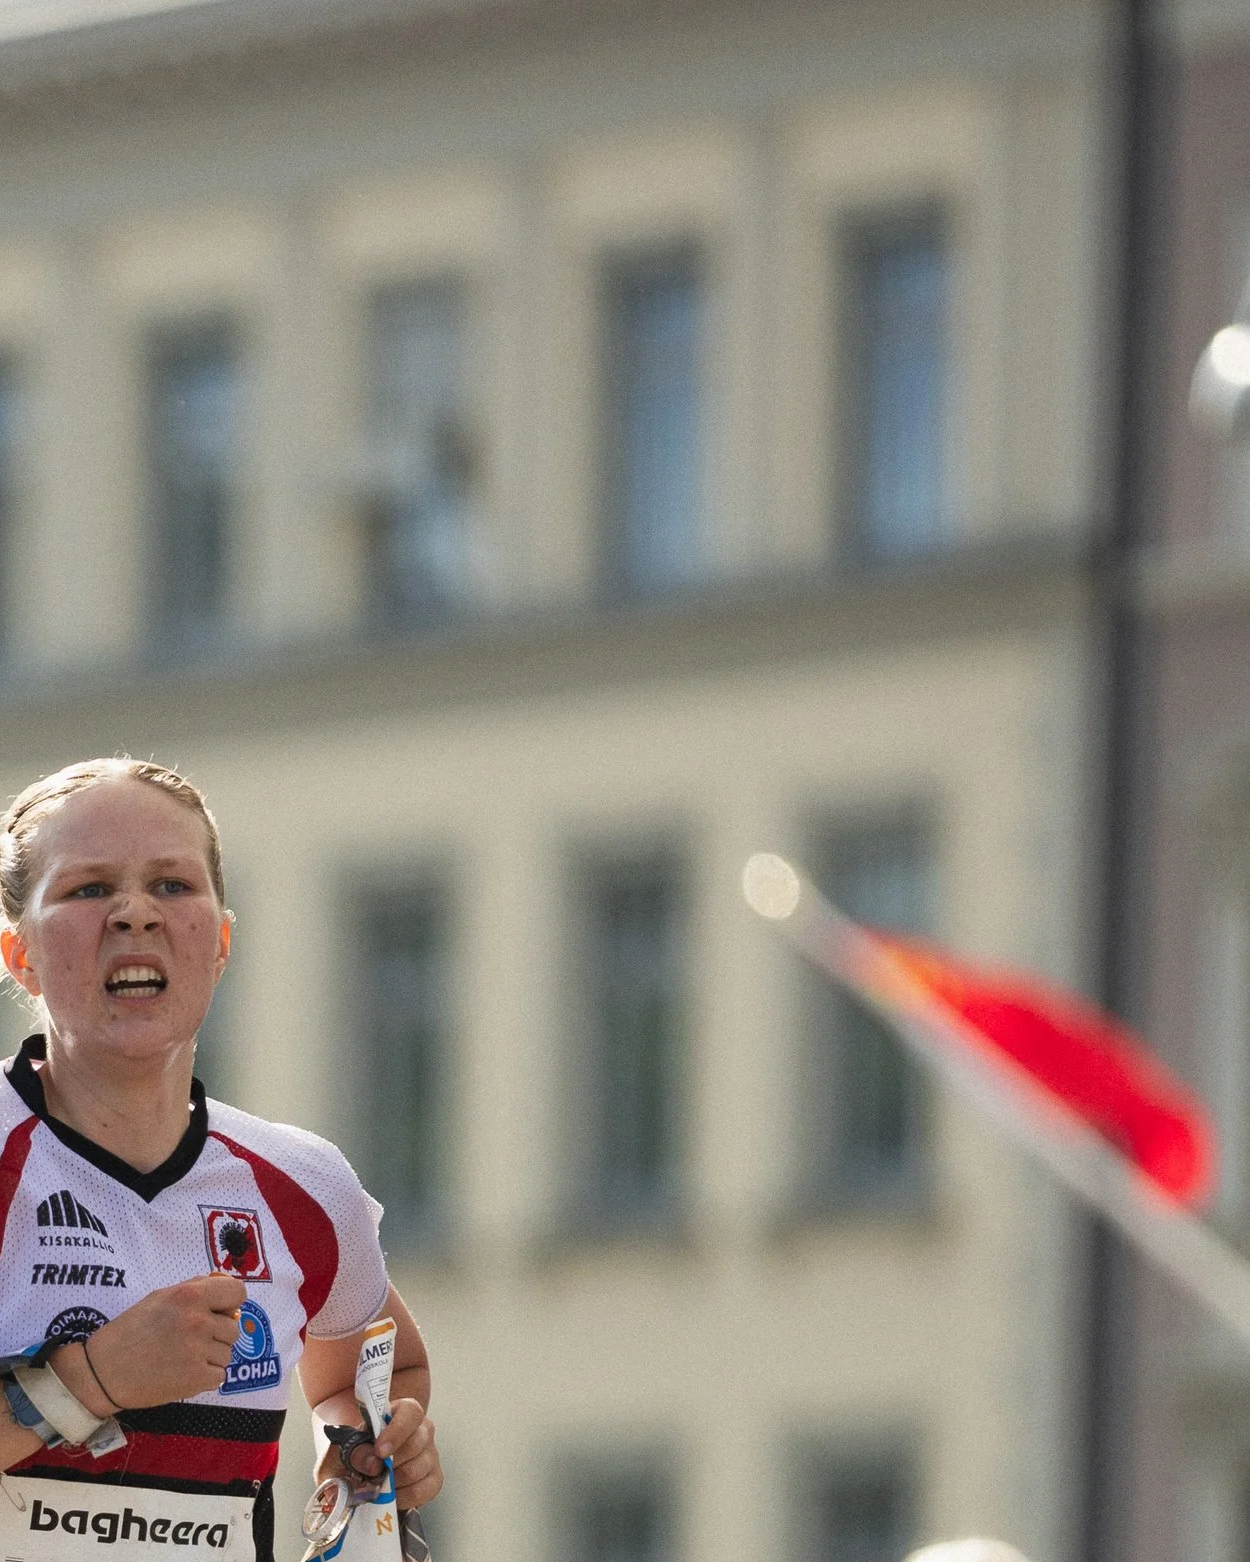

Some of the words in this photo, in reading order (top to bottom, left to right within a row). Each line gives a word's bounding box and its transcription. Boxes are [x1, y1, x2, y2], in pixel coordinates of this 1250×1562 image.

[38, 1235, 115, 1254] KISAKALLIO
[30, 1263, 127, 1288] TRIMTEX
[50, 1310, 107, 1337] OIMAPA
[226, 1359, 278, 1383] LOHJA
[29, 1500, 229, 1548] bagheera
